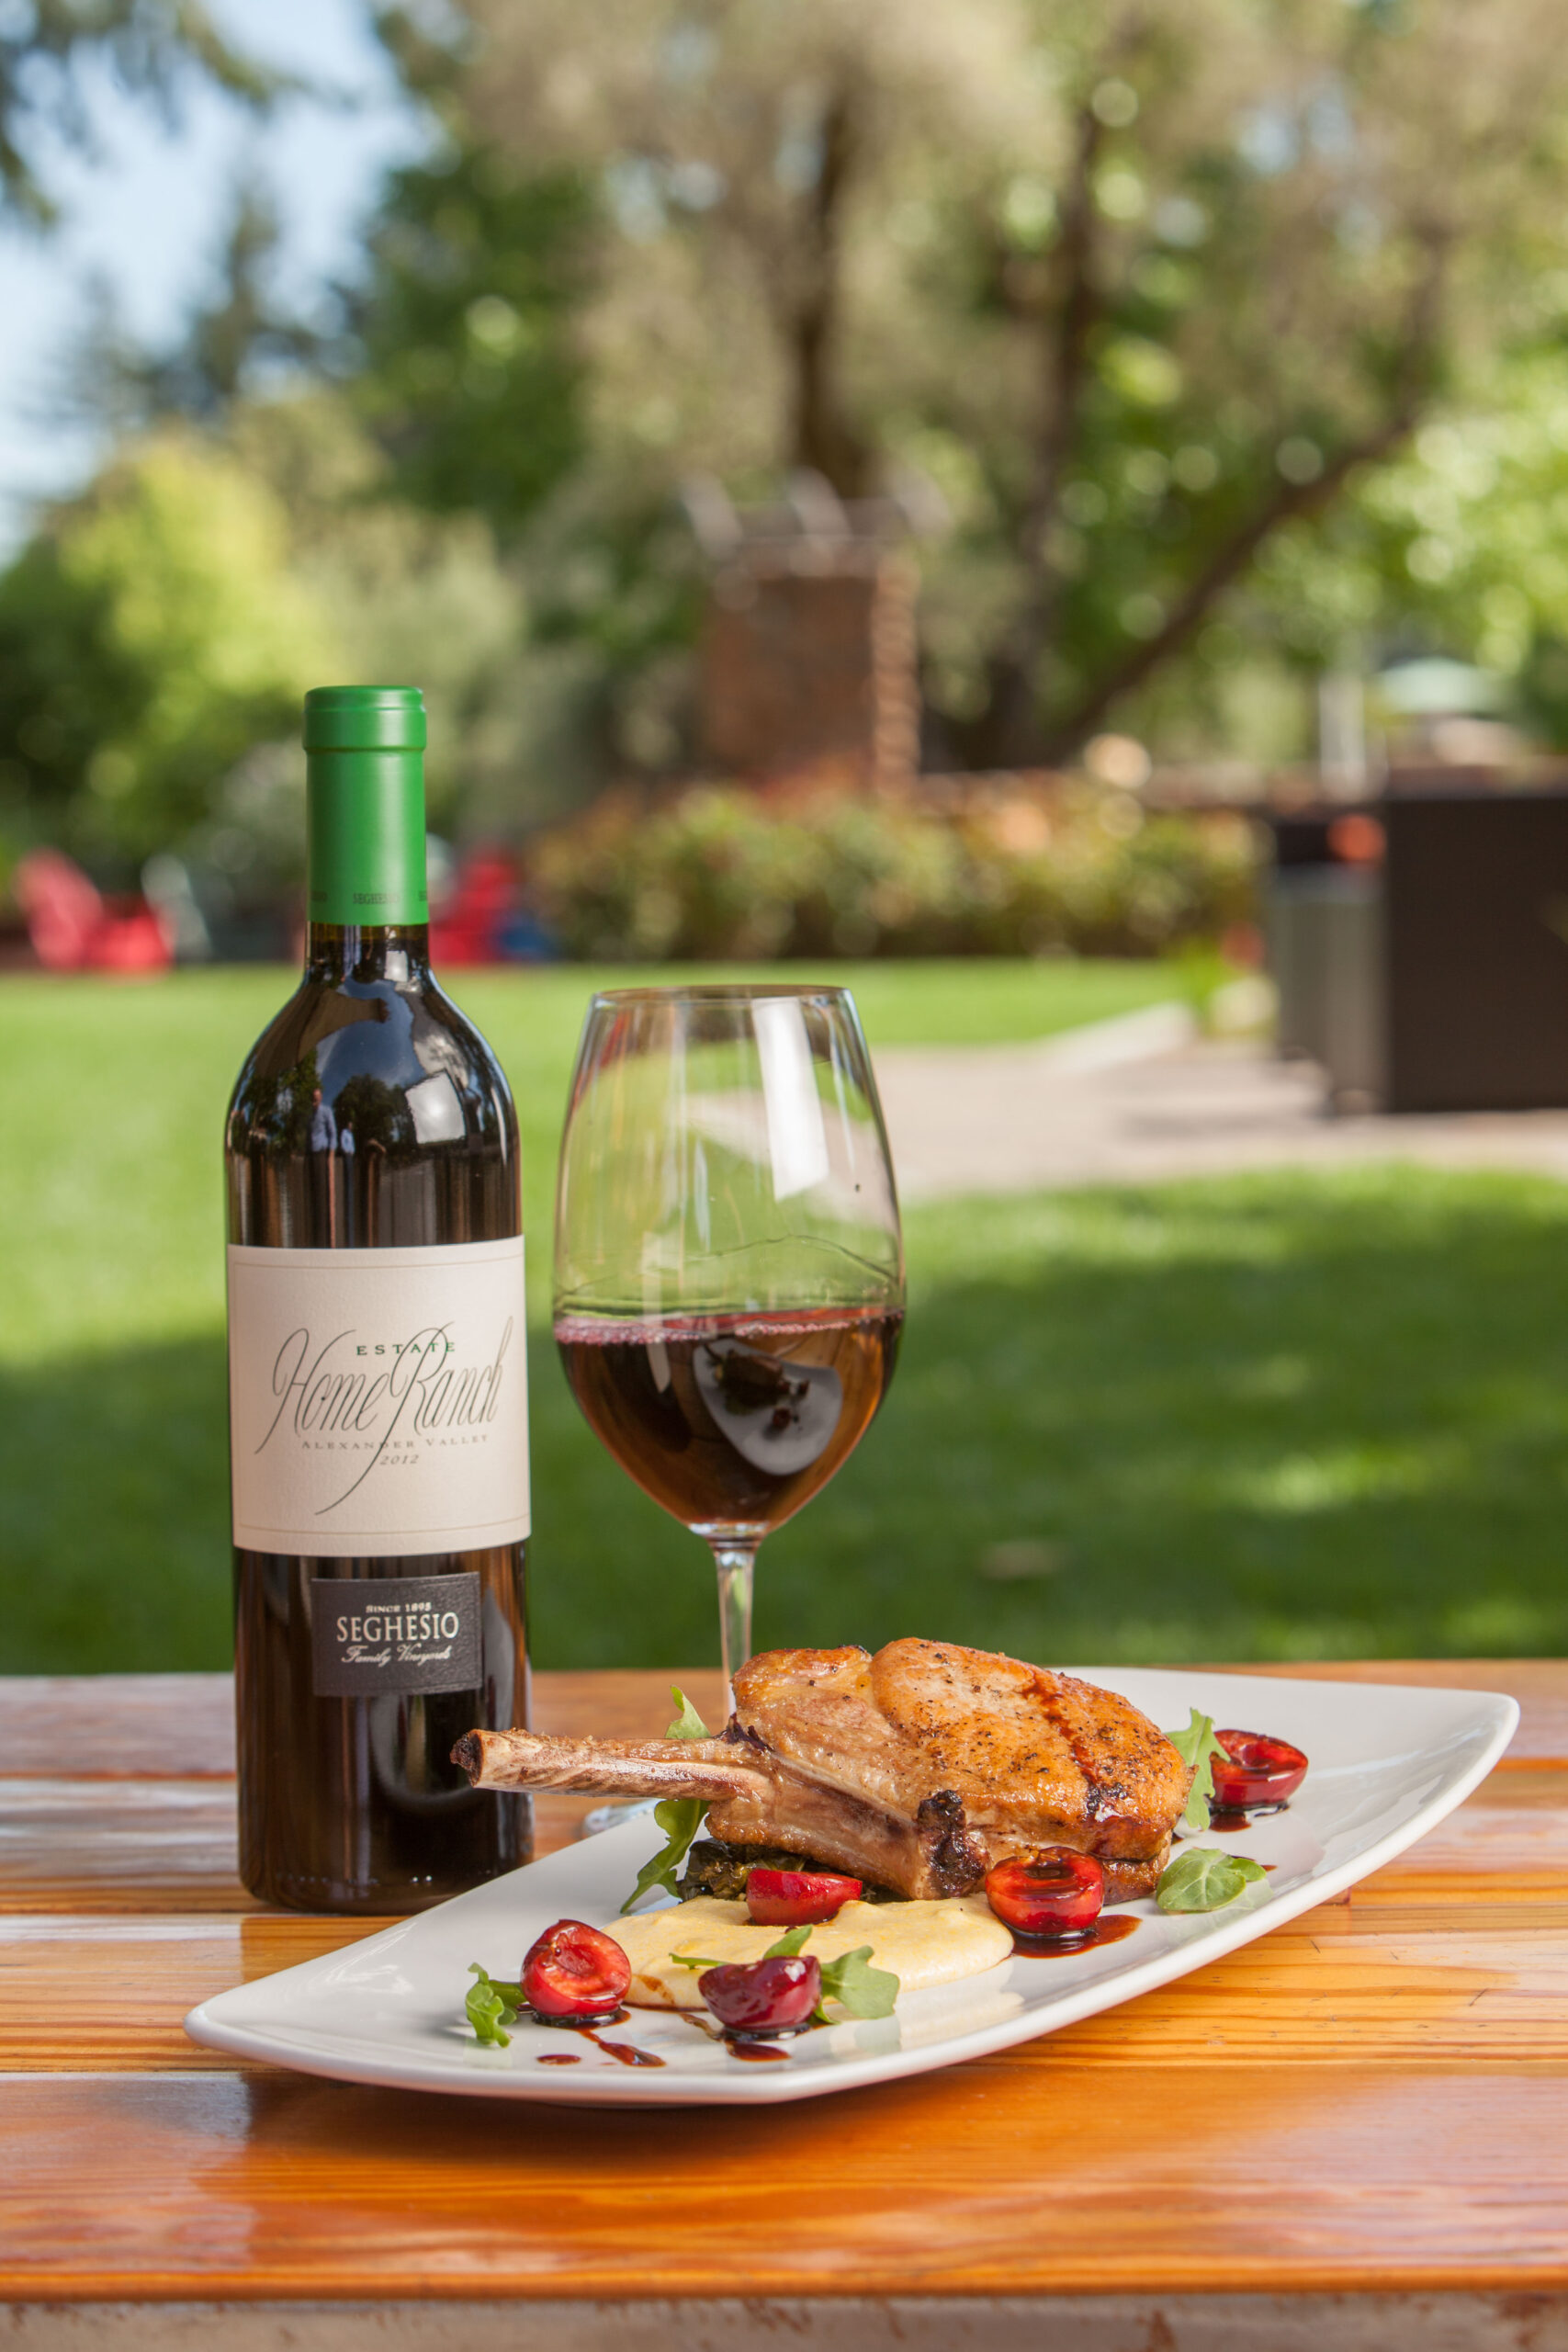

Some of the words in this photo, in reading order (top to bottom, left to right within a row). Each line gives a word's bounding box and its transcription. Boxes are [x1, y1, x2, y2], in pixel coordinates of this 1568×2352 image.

[356, 1340, 457, 1356] ESTATE
[254, 1328, 390, 1454] Home
[314, 1316, 513, 1516] Ranch
[301, 1440, 415, 1450] ALEXANDER
[425, 1434, 489, 1446] VALLEY
[379, 1454, 419, 1465] 2012
[366, 1604, 400, 1612] SINCE
[405, 1602, 432, 1612] 1895
[336, 1612, 459, 1642] SEGHESIO
[341, 1645, 391, 1668] Family
